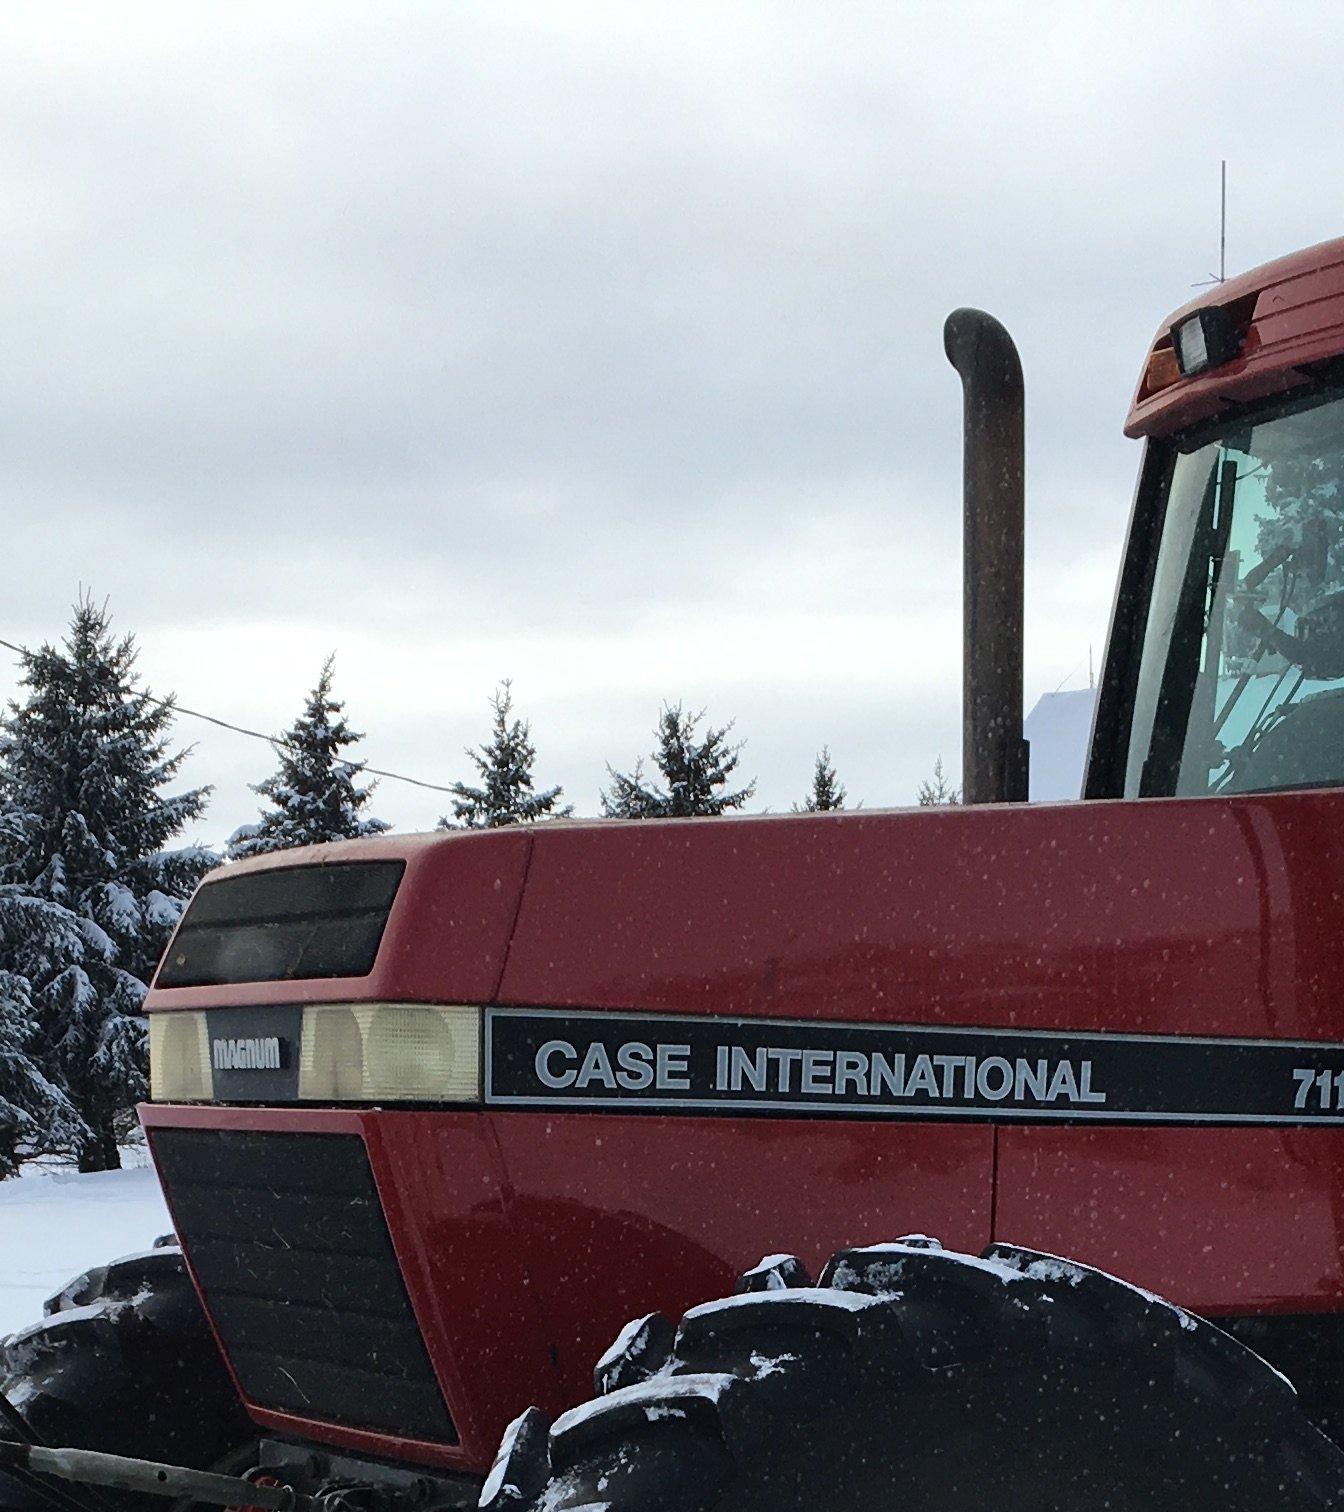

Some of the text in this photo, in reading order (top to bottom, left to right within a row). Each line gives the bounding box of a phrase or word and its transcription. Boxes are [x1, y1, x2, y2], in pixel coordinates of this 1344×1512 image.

[213, 1037, 280, 1069] MAGNUM
[534, 1040, 1106, 1102] CASE INTERNATIONAL
